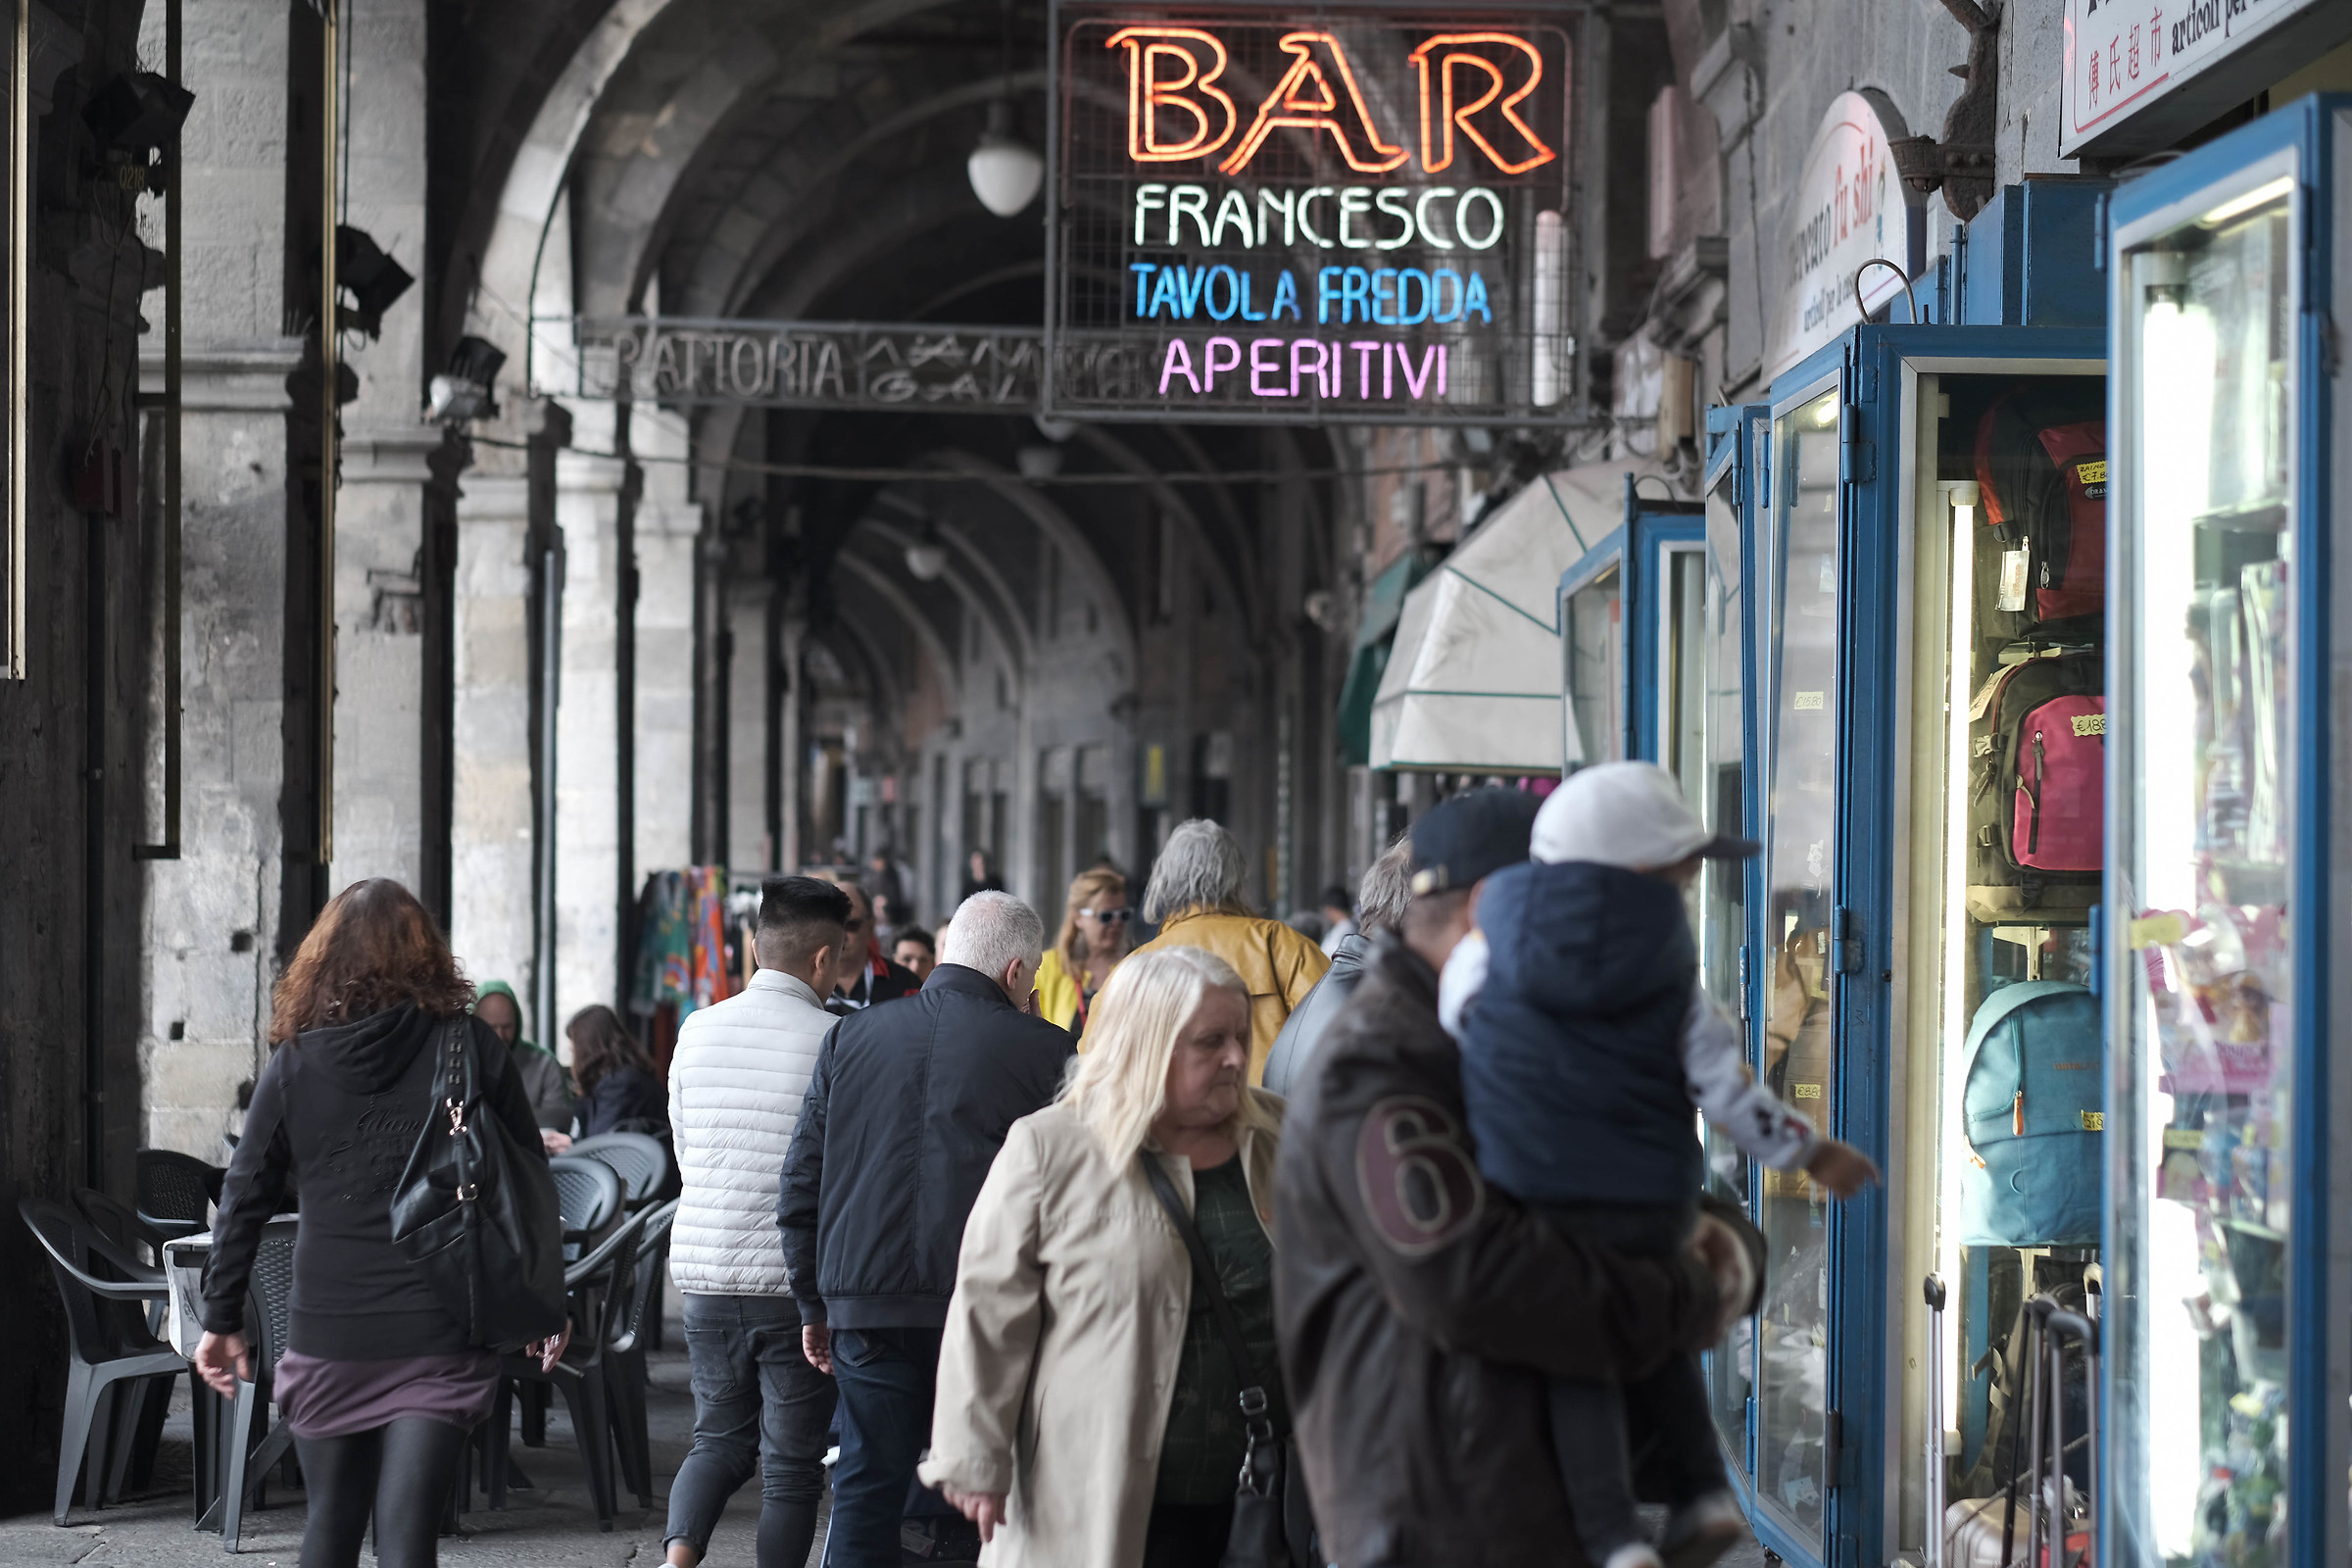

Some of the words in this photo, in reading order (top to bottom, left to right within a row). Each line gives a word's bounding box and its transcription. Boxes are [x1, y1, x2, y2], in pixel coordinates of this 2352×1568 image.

[1105, 26, 1556, 175] BAR
[1134, 183, 1503, 250] FRANCESCO
[1130, 262, 1301, 321] TAVOLA
[1318, 265, 1493, 325] FREDDA
[1159, 335, 1446, 400] APERITIVI
[1356, 1094, 1486, 1256] 6
